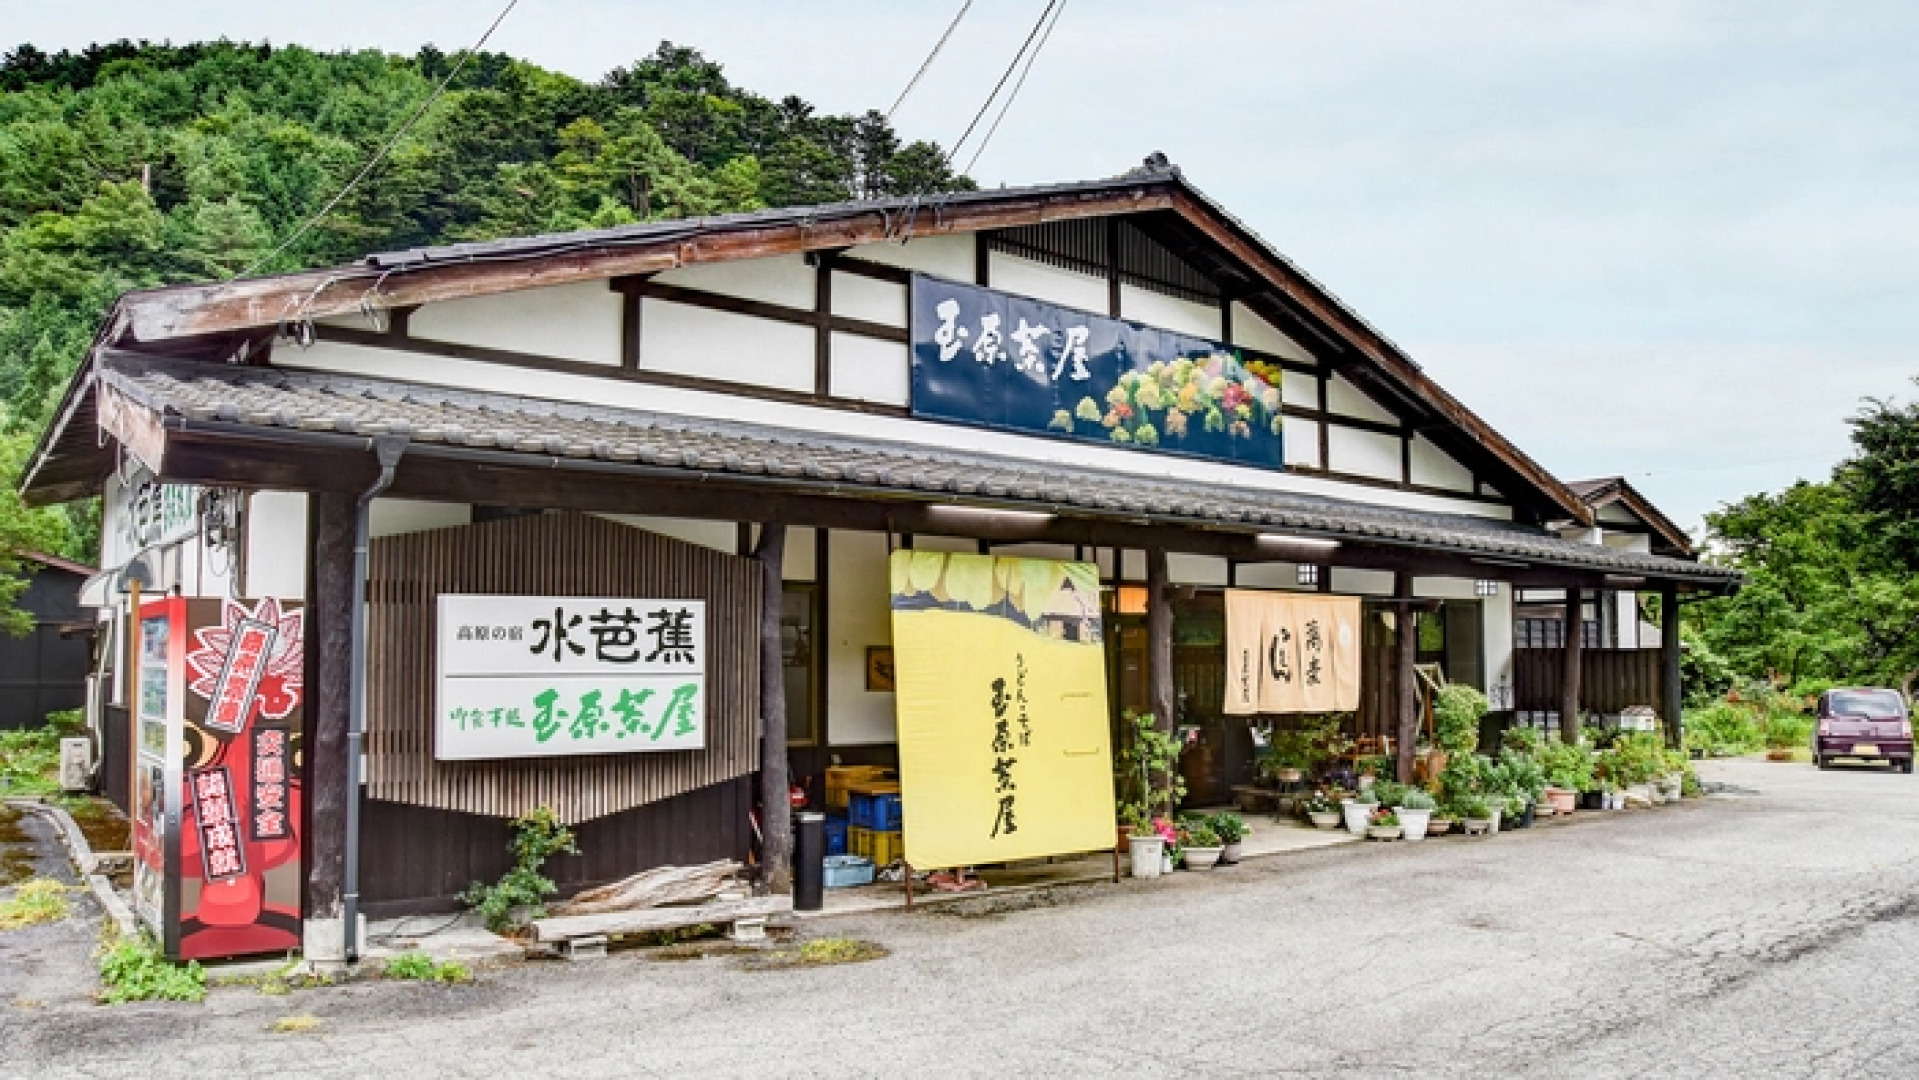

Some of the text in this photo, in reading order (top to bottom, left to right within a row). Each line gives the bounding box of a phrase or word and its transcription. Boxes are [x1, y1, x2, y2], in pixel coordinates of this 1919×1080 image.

[935, 297, 1091, 380] 玉原茶屋
[530, 607, 695, 663] 水芭蕉
[532, 683, 698, 743] 玉原茶屋
[256, 729, 285, 837] 交通安全
[990, 677, 1018, 839] 玉原茶屋
